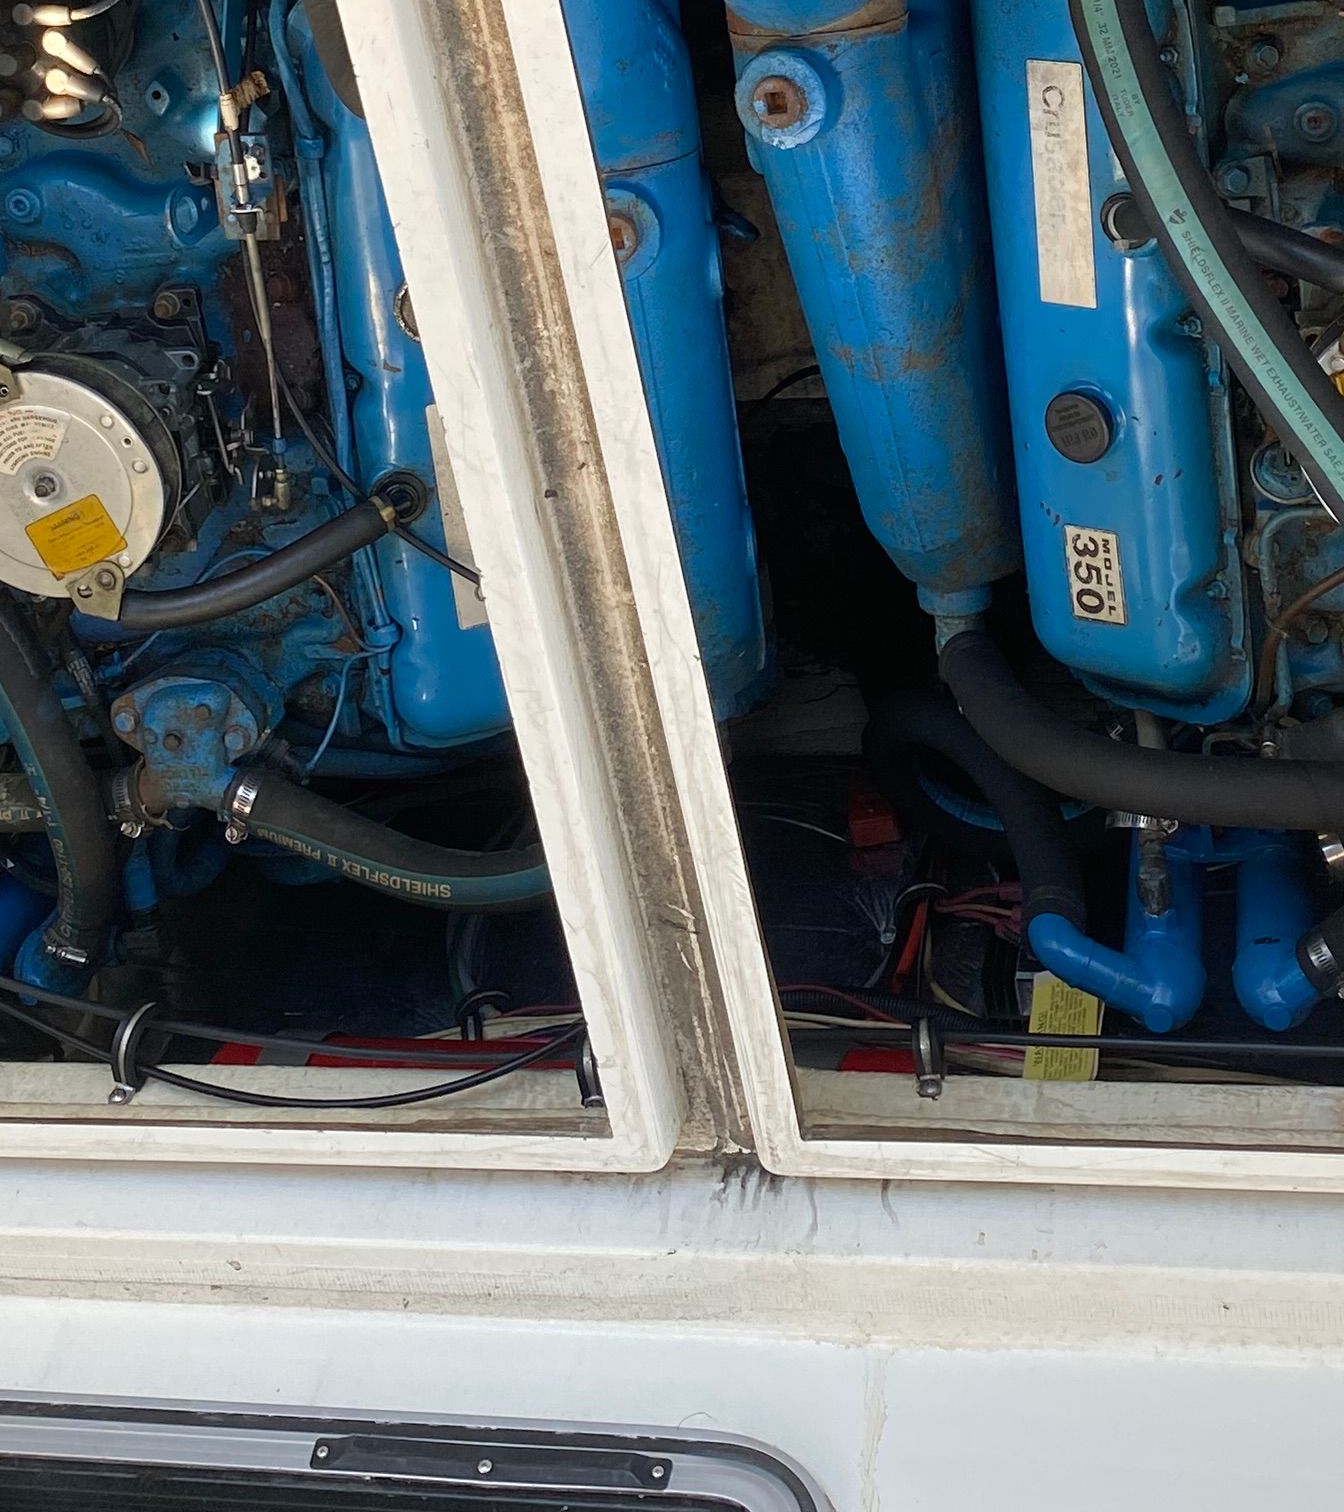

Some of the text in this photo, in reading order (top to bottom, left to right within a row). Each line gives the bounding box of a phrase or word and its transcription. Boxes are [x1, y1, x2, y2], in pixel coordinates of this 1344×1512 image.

[1107, 55, 1123, 80] 2021
[1180, 229, 1225, 299] SHIELDSFLEX
[1224, 305, 1255, 345] MARINE
[1249, 344, 1271, 368] WET
[1264, 367, 1328, 450] EXHAUST/WATER
[1322, 448, 1342, 469] SAE
[1072, 534, 1105, 614] 350
[254, 826, 322, 860] PREMIUM
[340, 858, 451, 898] SHIELDSFLEX
